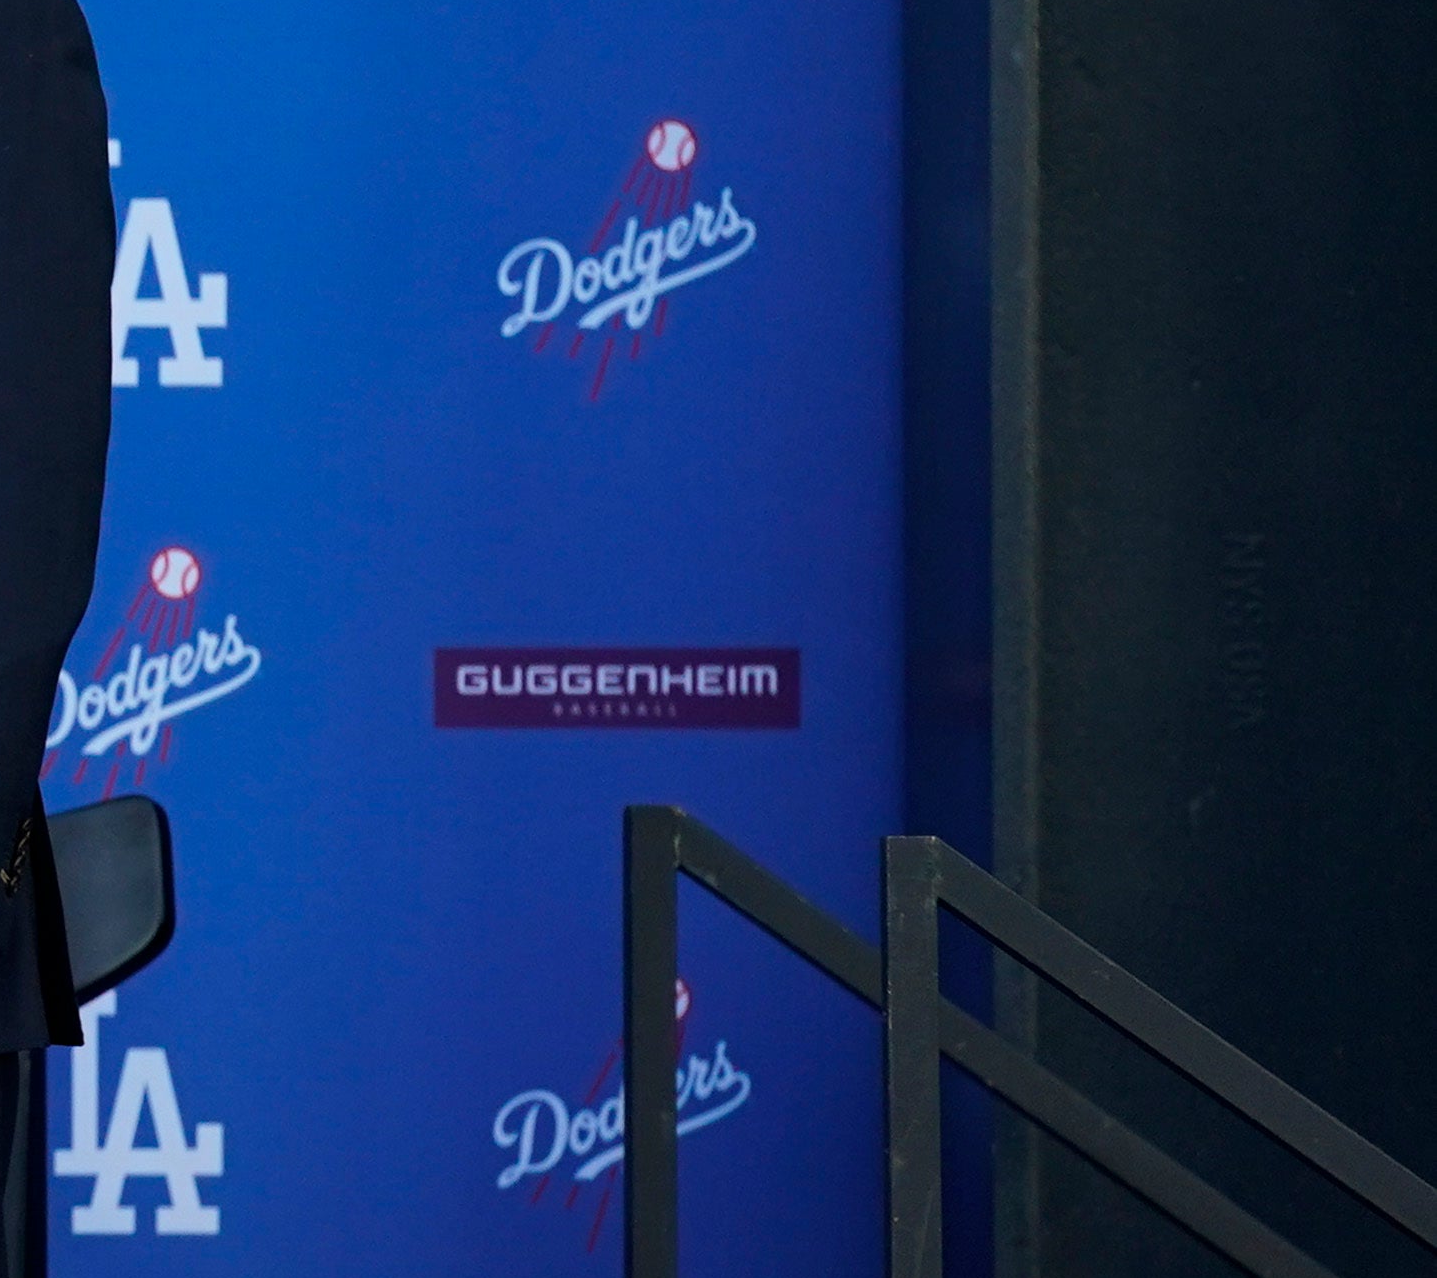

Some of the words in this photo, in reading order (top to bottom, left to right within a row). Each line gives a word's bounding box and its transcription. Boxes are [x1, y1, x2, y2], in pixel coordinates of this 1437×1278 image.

[498, 188, 757, 337] Dodgers
[456, 664, 778, 696] GUGGENHEIM
[53, 988, 224, 1236] LA
